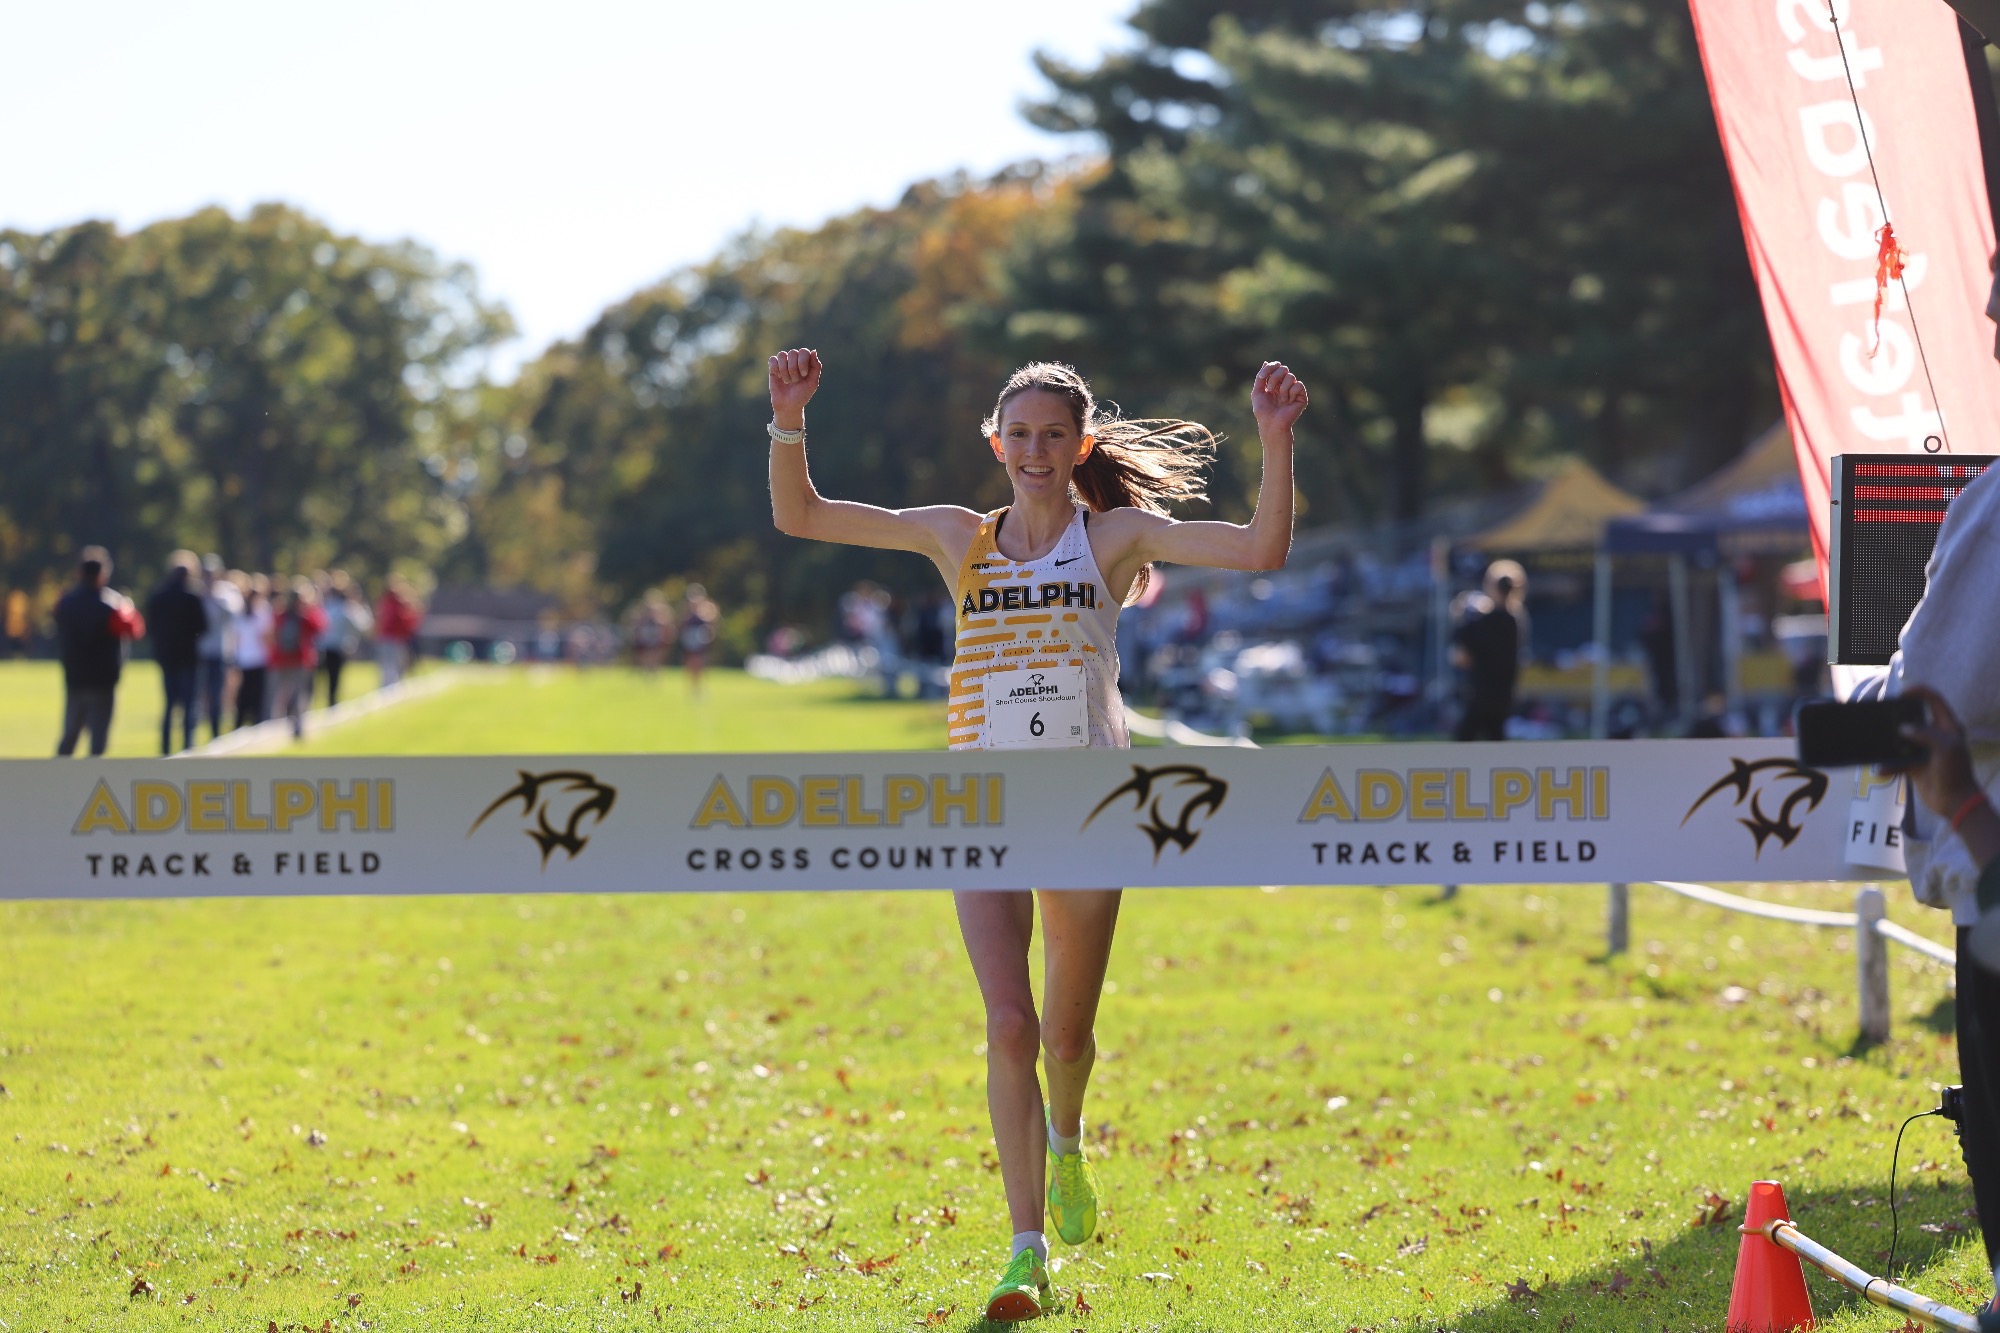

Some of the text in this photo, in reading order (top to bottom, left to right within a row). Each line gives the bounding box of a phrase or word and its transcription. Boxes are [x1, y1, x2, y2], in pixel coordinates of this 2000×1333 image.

[962, 583, 1096, 617] ADELPHI
[1009, 685, 1058, 697] ADELPHI
[1029, 711, 1045, 737] 6
[71, 777, 396, 834] ADELPHI
[688, 772, 1005, 830] ADELPHI
[1297, 766, 1610, 823] ADELPHI
[86, 852, 380, 876] TRACK & FIELD
[687, 845, 1008, 871] CROSS COUNTRY
[1311, 840, 1597, 865] TRACK & FIELD
